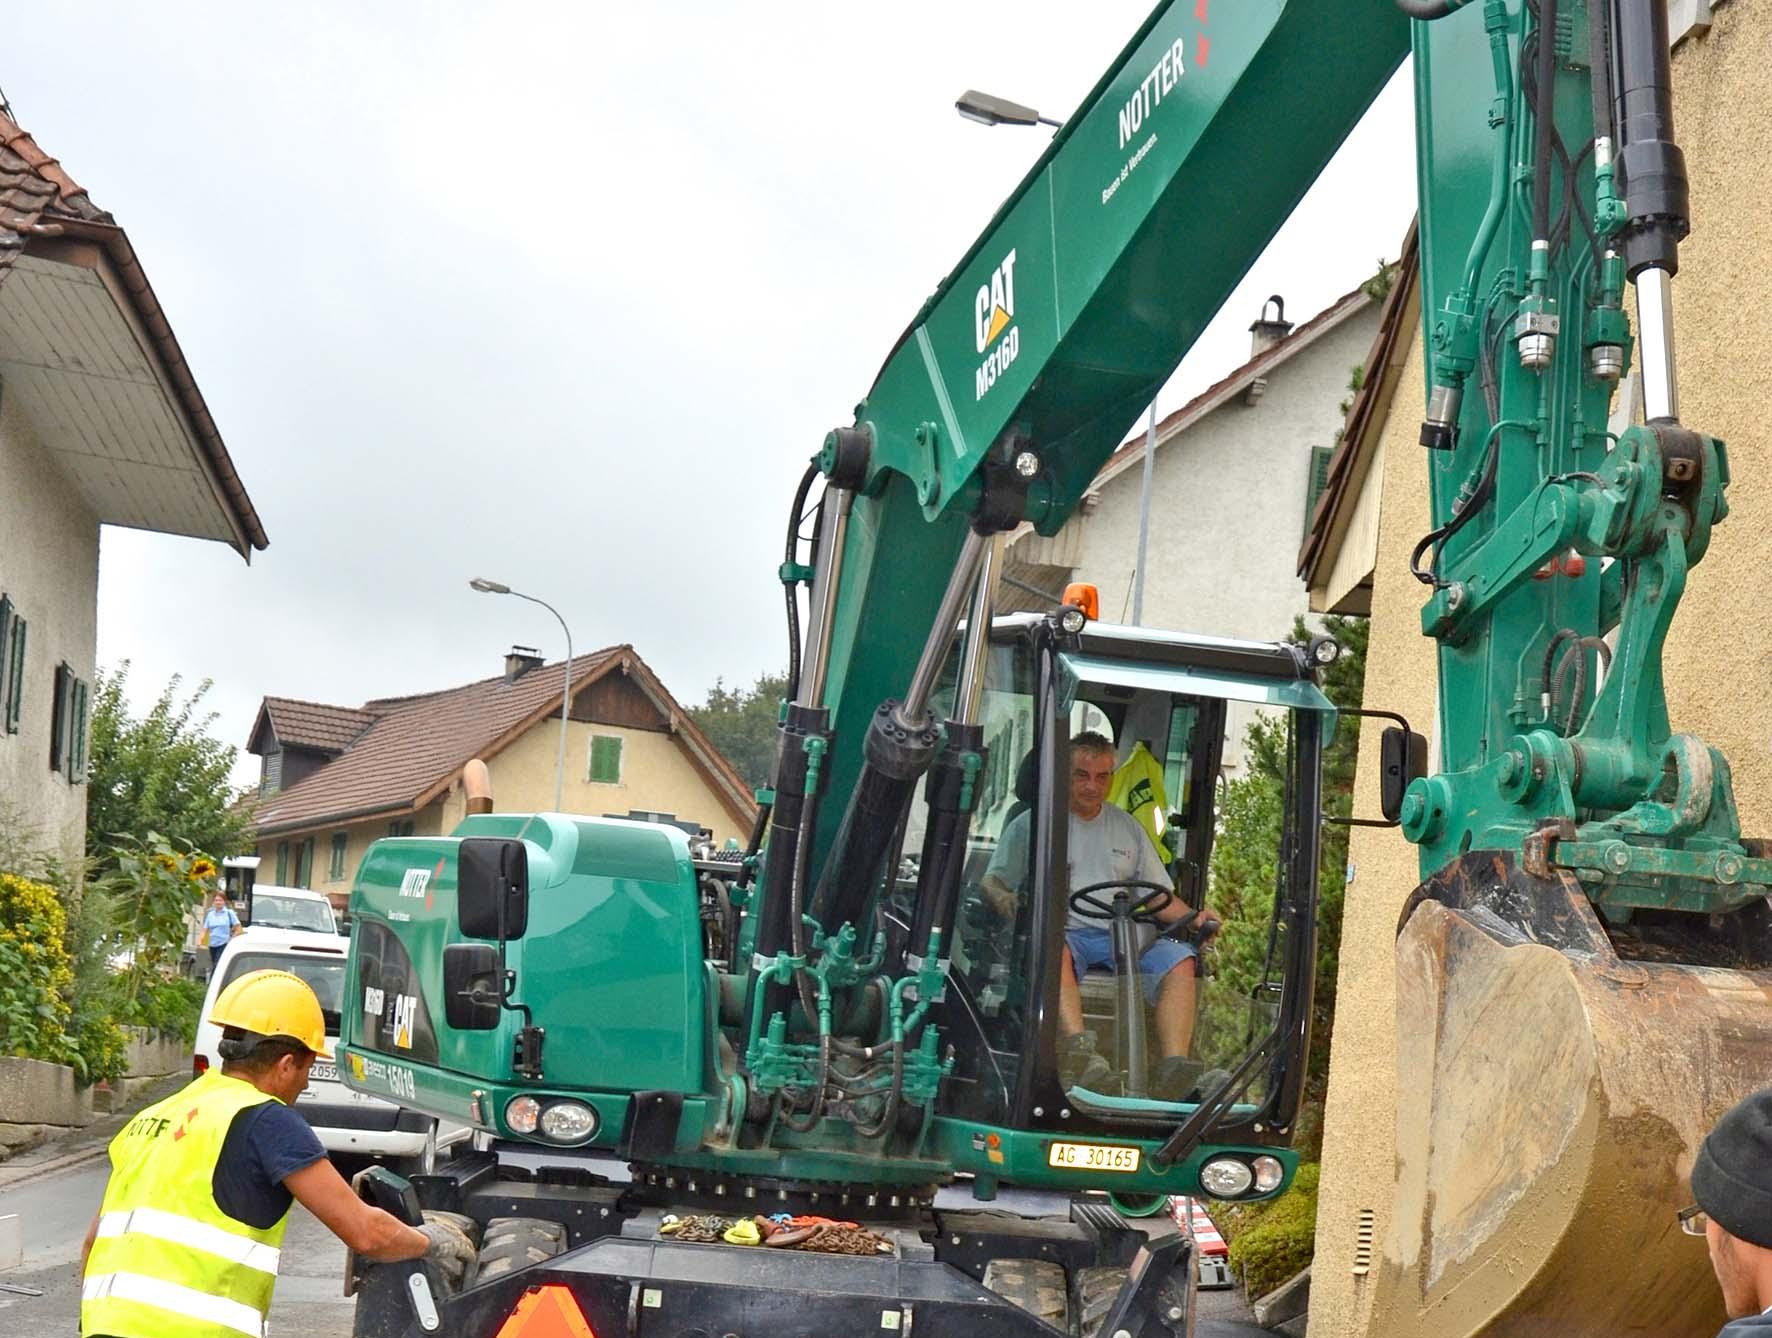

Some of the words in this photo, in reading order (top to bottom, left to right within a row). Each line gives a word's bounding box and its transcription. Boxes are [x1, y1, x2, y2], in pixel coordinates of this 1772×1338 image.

[1119, 37, 1185, 150] NOTTER
[975, 247, 1017, 354] CAT
[976, 325, 1019, 402] M316D
[393, 993, 417, 1050] CAT
[387, 1064, 416, 1100] 15019
[1056, 1146, 1076, 1163] AG
[1086, 1148, 1133, 1168] 30165
